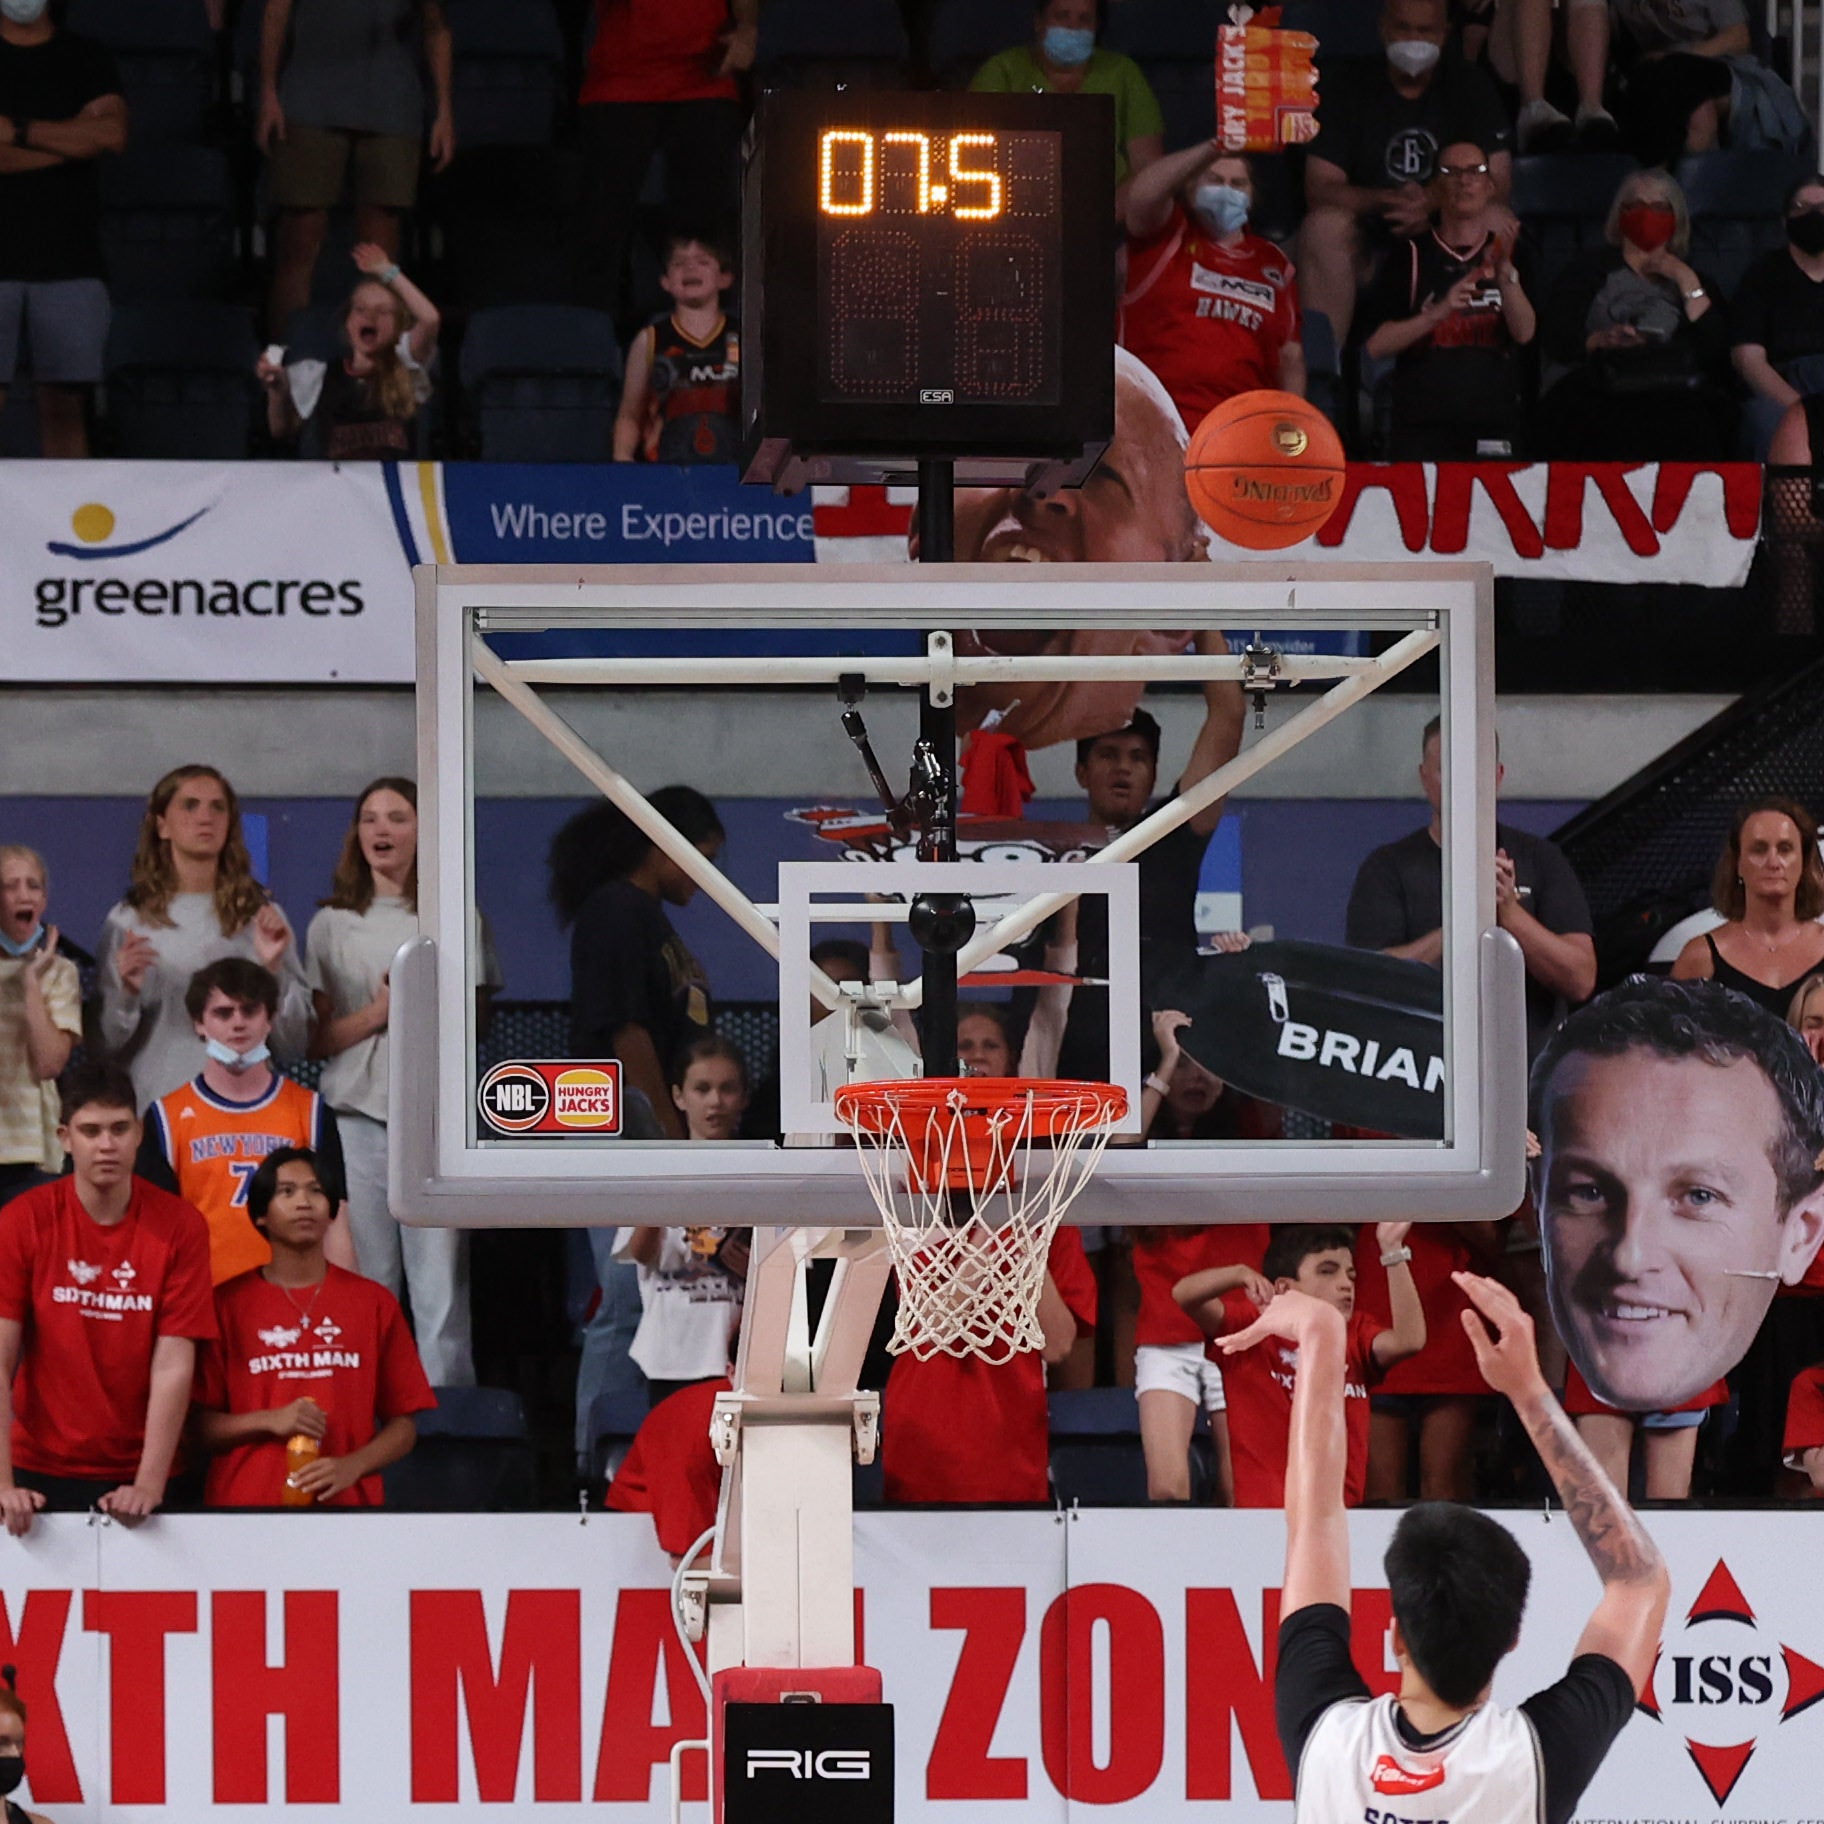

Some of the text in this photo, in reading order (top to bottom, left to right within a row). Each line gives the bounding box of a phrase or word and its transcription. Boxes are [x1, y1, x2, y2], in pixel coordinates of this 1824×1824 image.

[1222, 105, 1247, 151] GRY
[1194, 297, 1265, 331] HAWKS
[490, 503, 607, 541] Where
[622, 503, 815, 547] Experience
[35, 576, 366, 628] greenacres
[496, 1084, 536, 1112] NBL
[558, 1087, 610, 1097] HUNGRY
[190, 1134, 238, 1163] NEW
[106, 1293, 153, 1312] MAN
[249, 1352, 310, 1375] SIXTH
[313, 1350, 361, 1370] MAN
[408, 1587, 864, 1804] MA
[925, 1583, 1402, 1806] ZON
[1671, 1655, 1774, 1705] ISS
[745, 1748, 871, 1780] RIG
